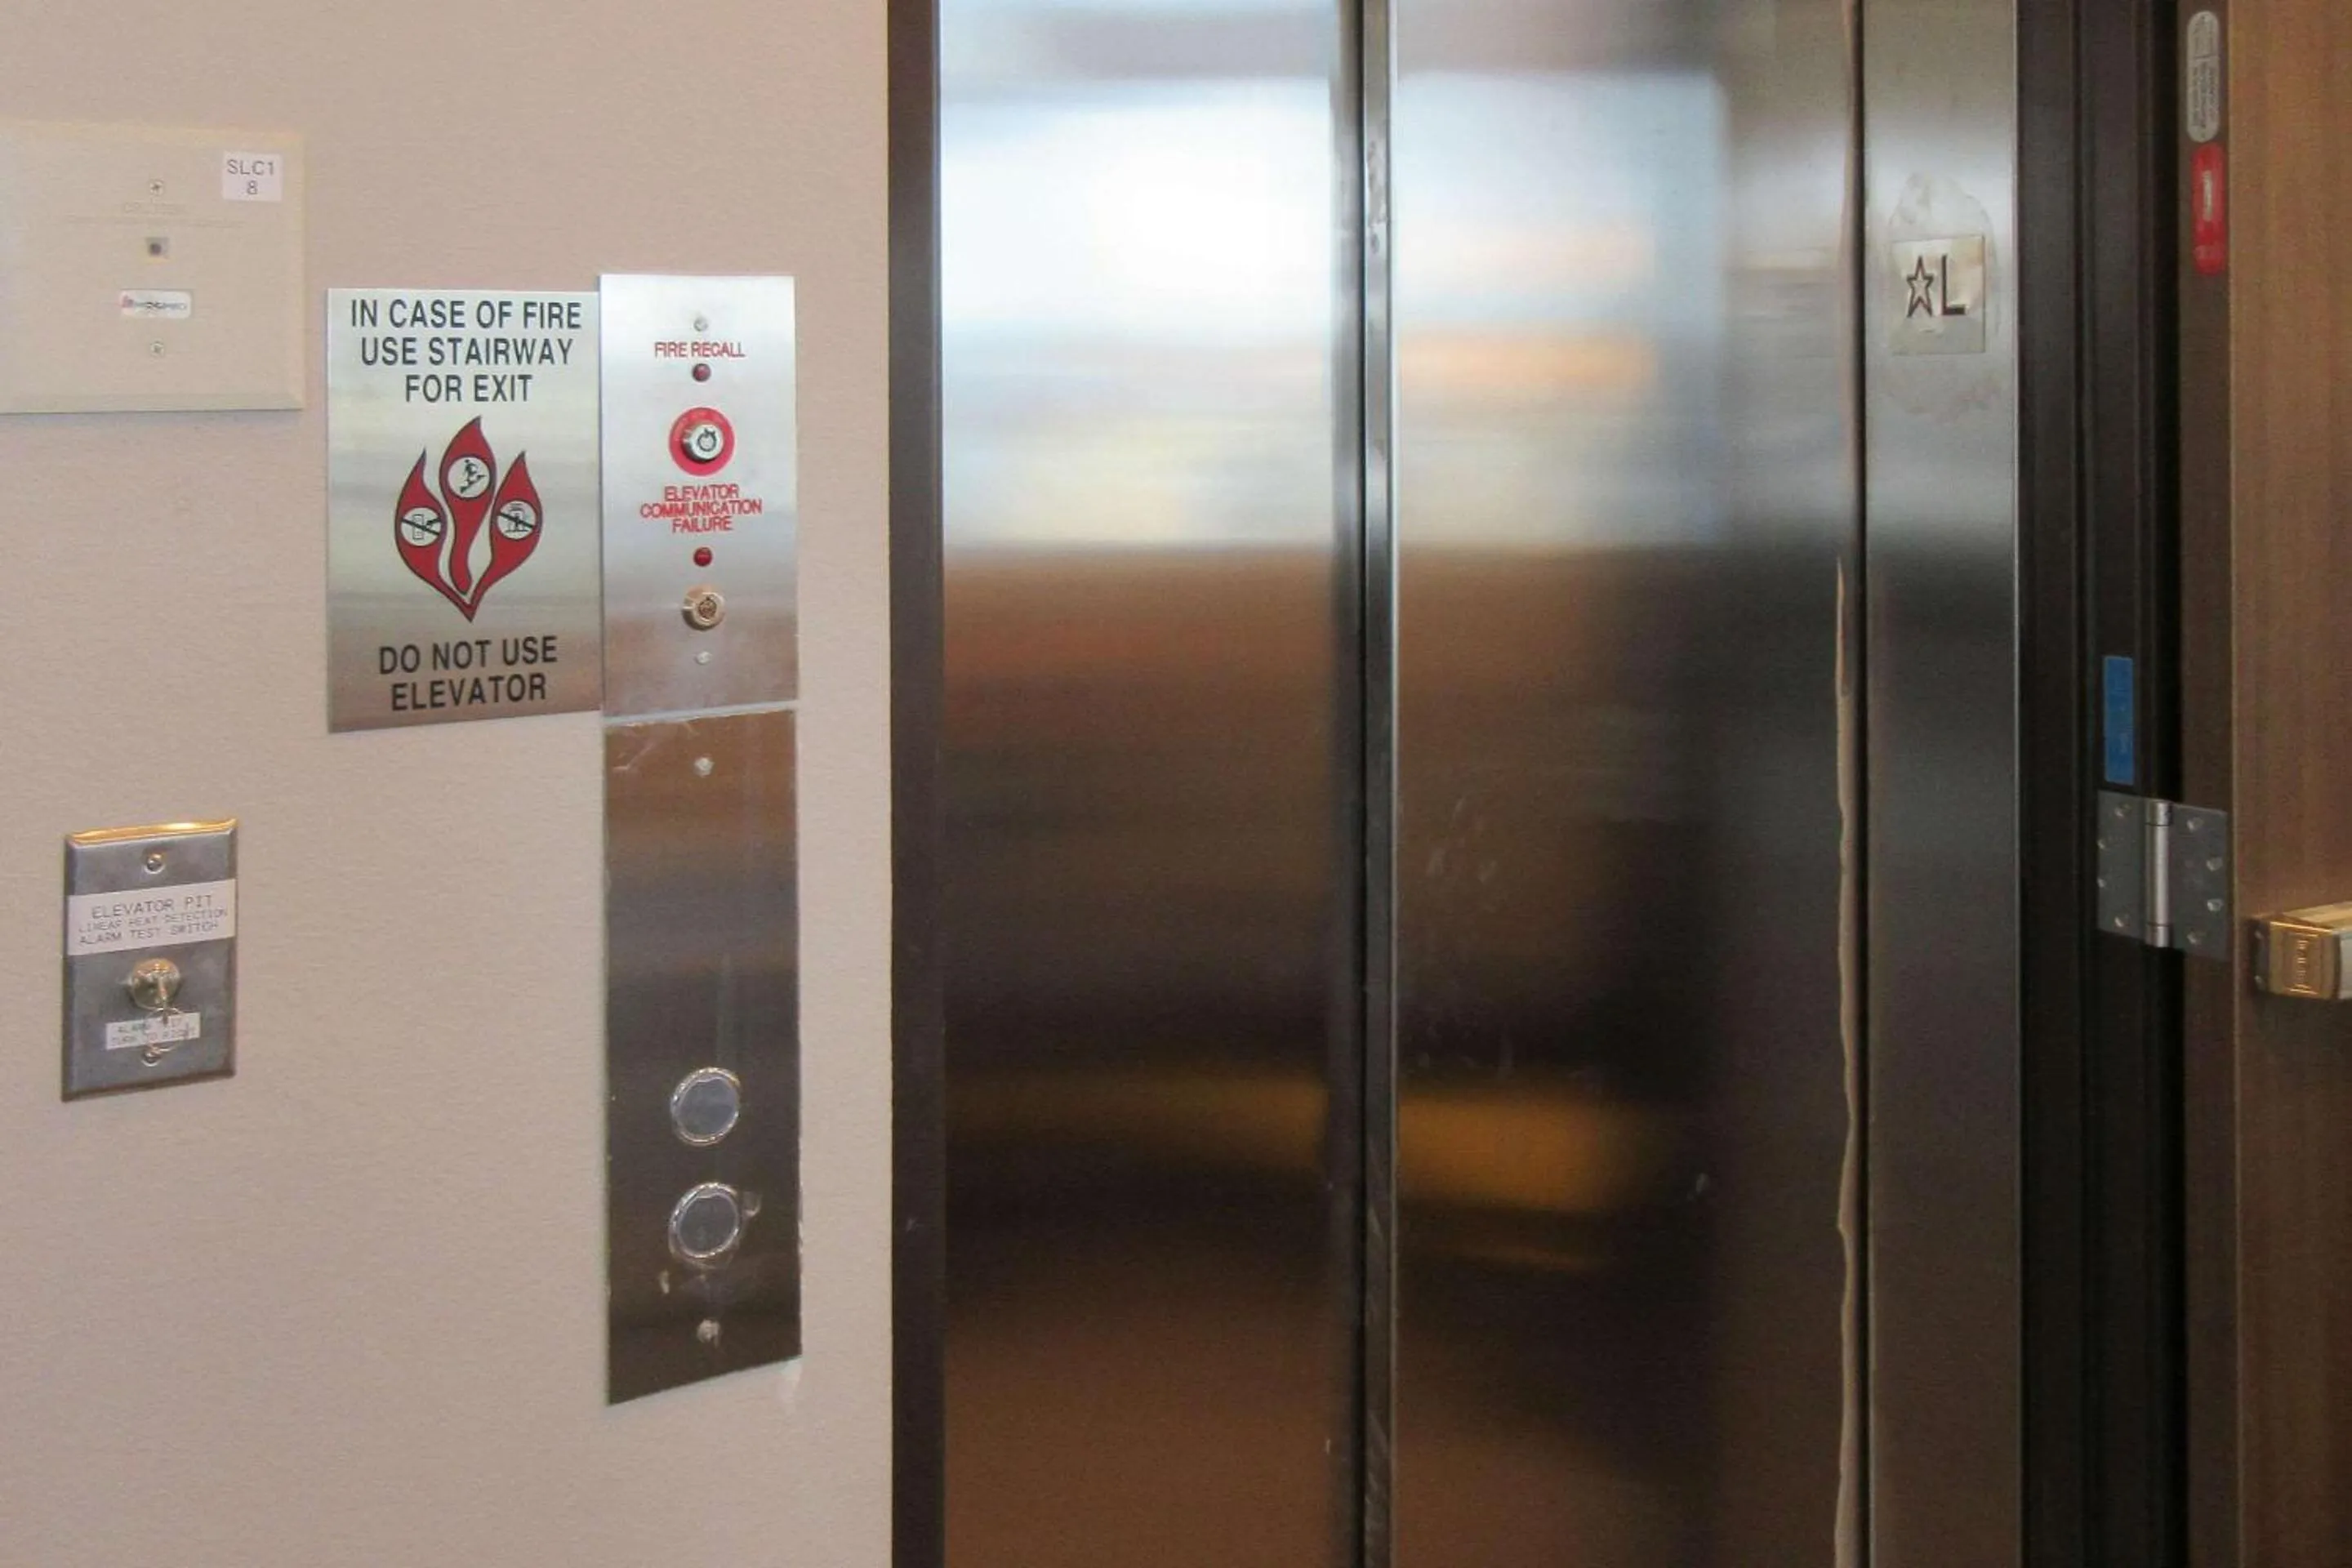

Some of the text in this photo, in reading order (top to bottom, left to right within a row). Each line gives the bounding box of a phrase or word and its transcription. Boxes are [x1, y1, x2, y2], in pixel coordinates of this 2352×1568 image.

[227, 158, 274, 176] SLC1
[247, 180, 259, 195] 8
[351, 298, 581, 329] IN CASE OF FIRE
[361, 336, 573, 366] USE STAIRWAY
[654, 341, 747, 358] FIRE RECALL
[405, 374, 533, 403] FOR EXIT
[664, 483, 740, 501] ELEVATOR
[639, 499, 762, 518] COMMUNICATION
[672, 515, 733, 532] FAILURE
[379, 635, 558, 675] DO NOT USE
[391, 672, 546, 711] ELEVATOR
[91, 894, 212, 920] ELEVATOR PIT
[131, 927, 162, 939] TEST
